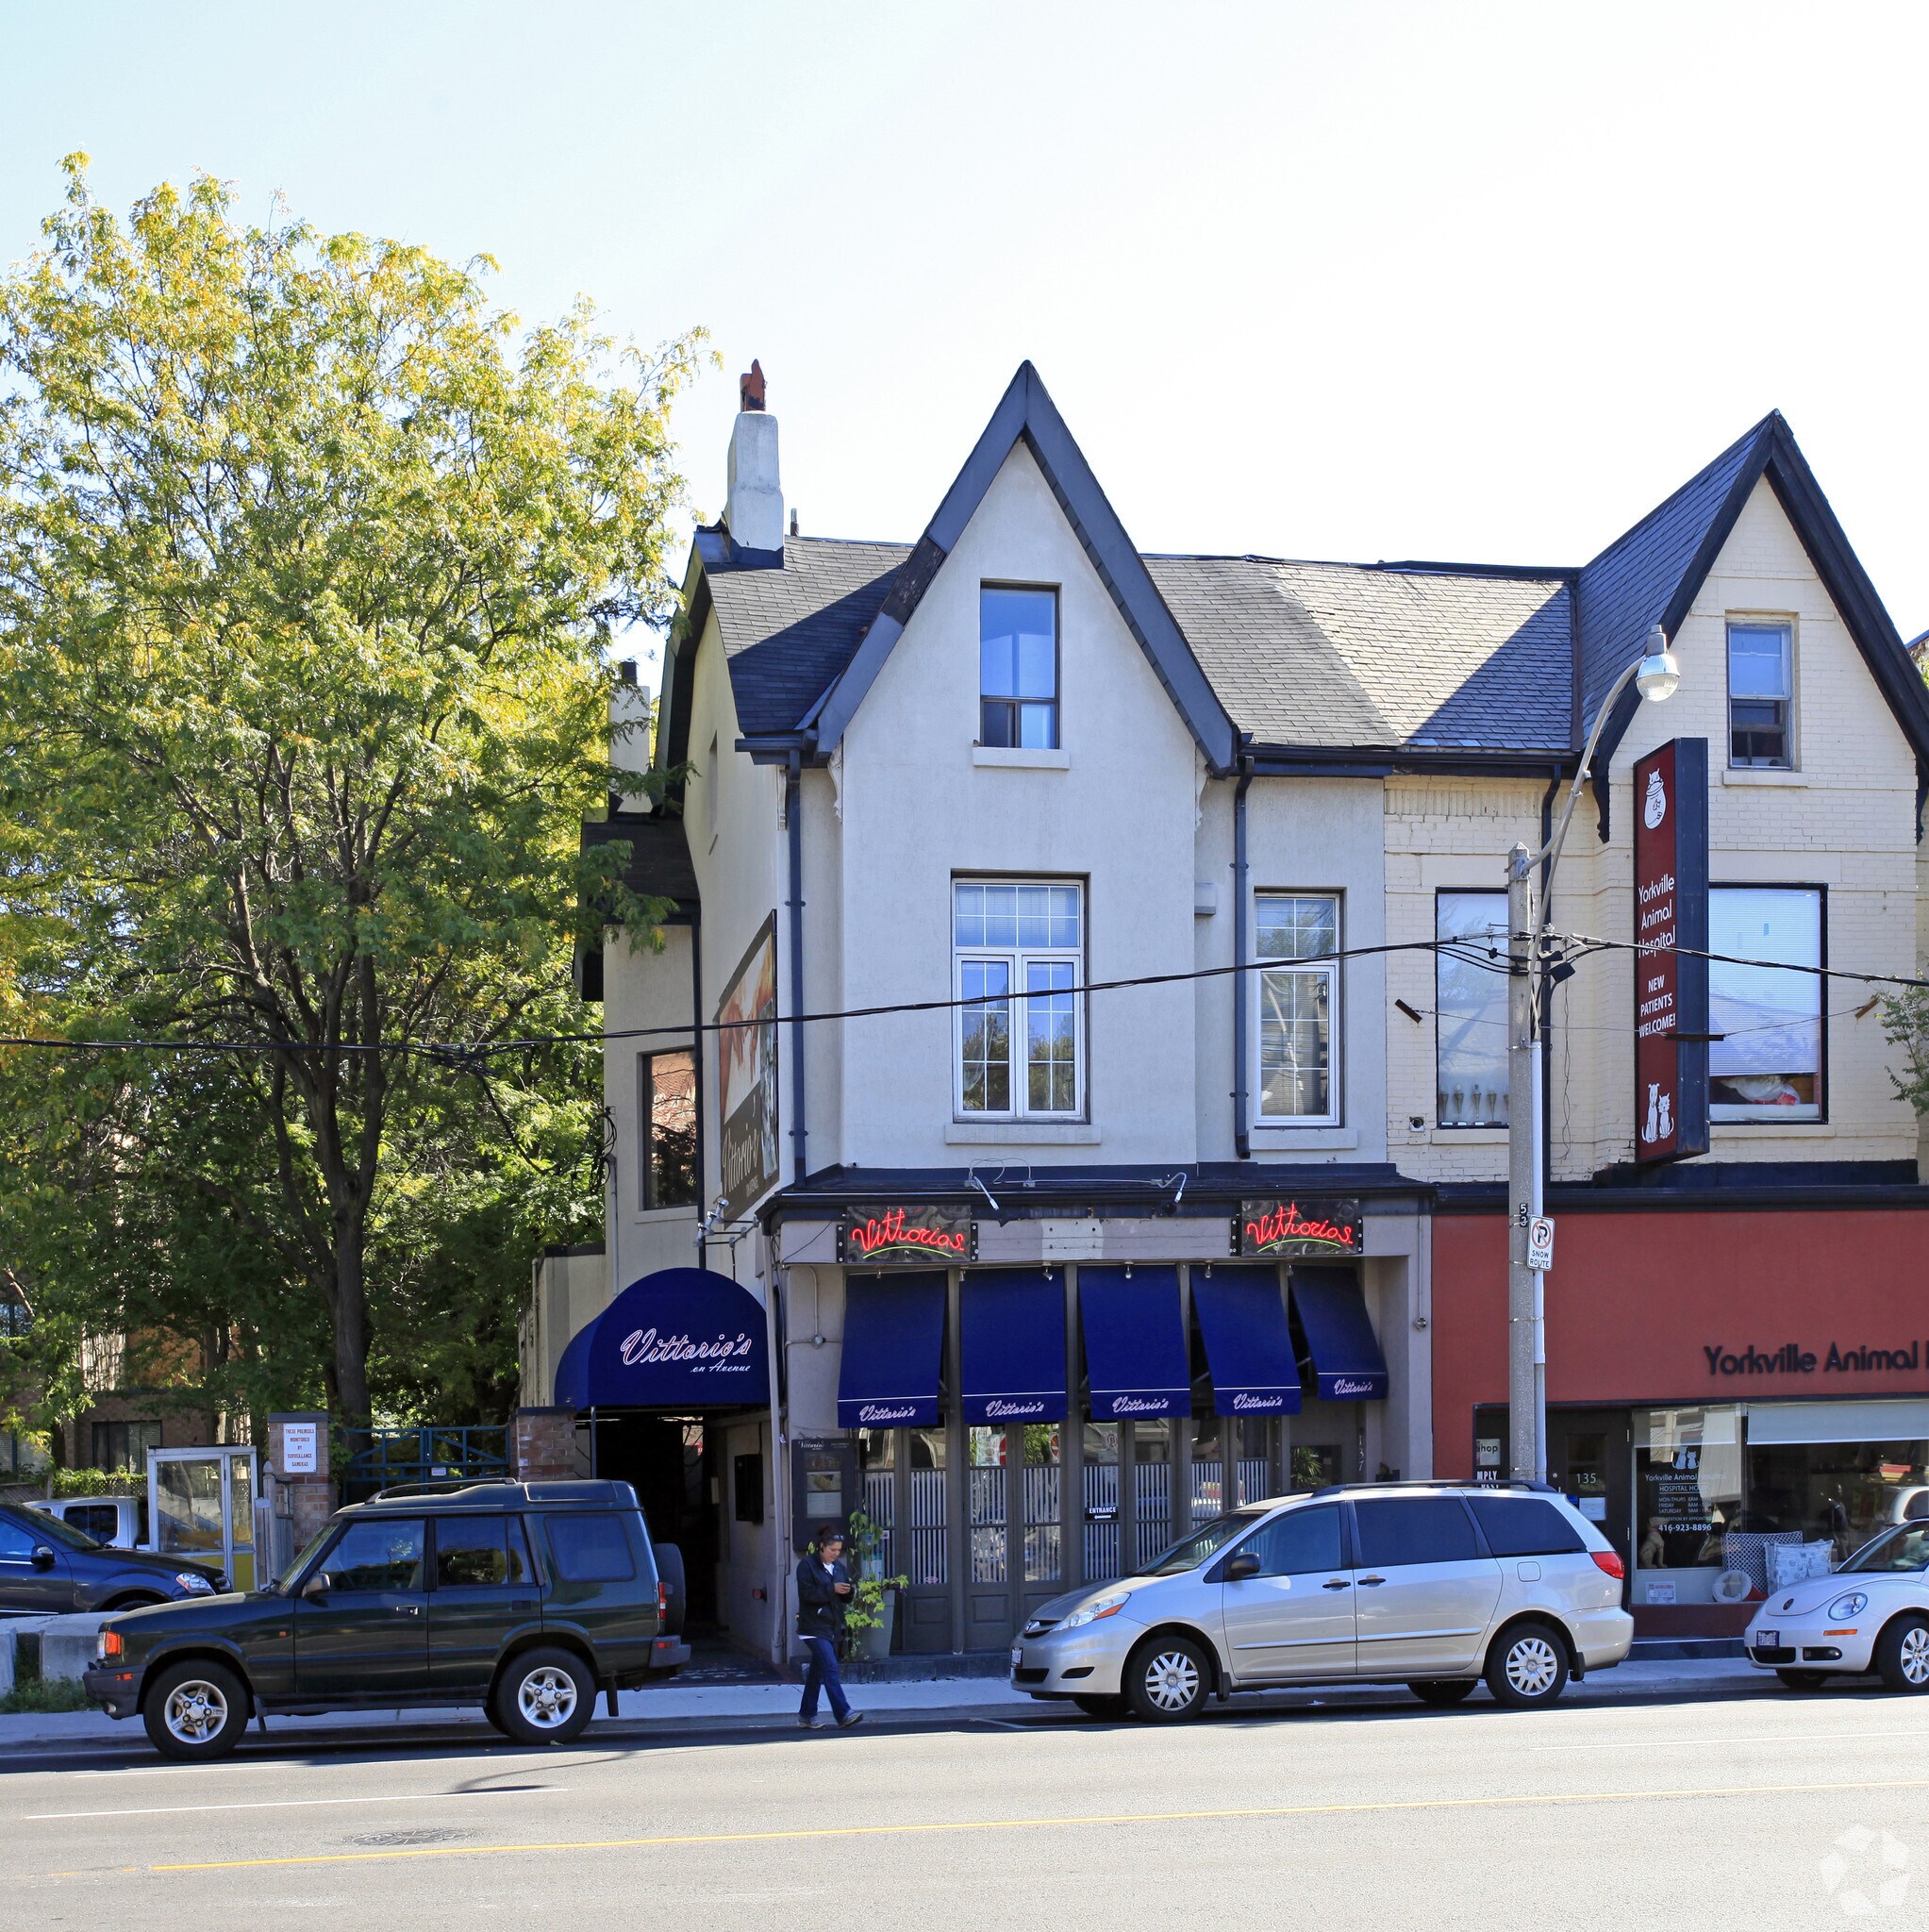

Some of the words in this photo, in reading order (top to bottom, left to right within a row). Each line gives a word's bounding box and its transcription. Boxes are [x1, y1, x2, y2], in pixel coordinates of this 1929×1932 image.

[1638, 874, 1675, 905] Yorkville
[1641, 899, 1672, 931] Animal
[1638, 925, 1675, 958] Hospital
[1648, 974, 1665, 992] NEW
[1640, 992, 1673, 1017] PATIENTS
[1638, 1012, 1676, 1038] WELCOME!
[1529, 1257, 1550, 1268] ROUTE
[1531, 1250, 1550, 1258] SNOW
[620, 1328, 752, 1365] Vittorio's
[708, 1358, 751, 1373] Avenue
[1704, 1343, 1817, 1375] Yorkville
[1823, 1341, 1919, 1372] Animal
[1334, 1379, 1373, 1395] Vittorio's
[985, 1400, 1045, 1418] Vittorio's
[1112, 1395, 1170, 1413] Vittorio's
[1233, 1393, 1284, 1410] Vittorio's
[858, 1405, 917, 1422] Vittorio's
[1576, 1473, 1596, 1484] 135
